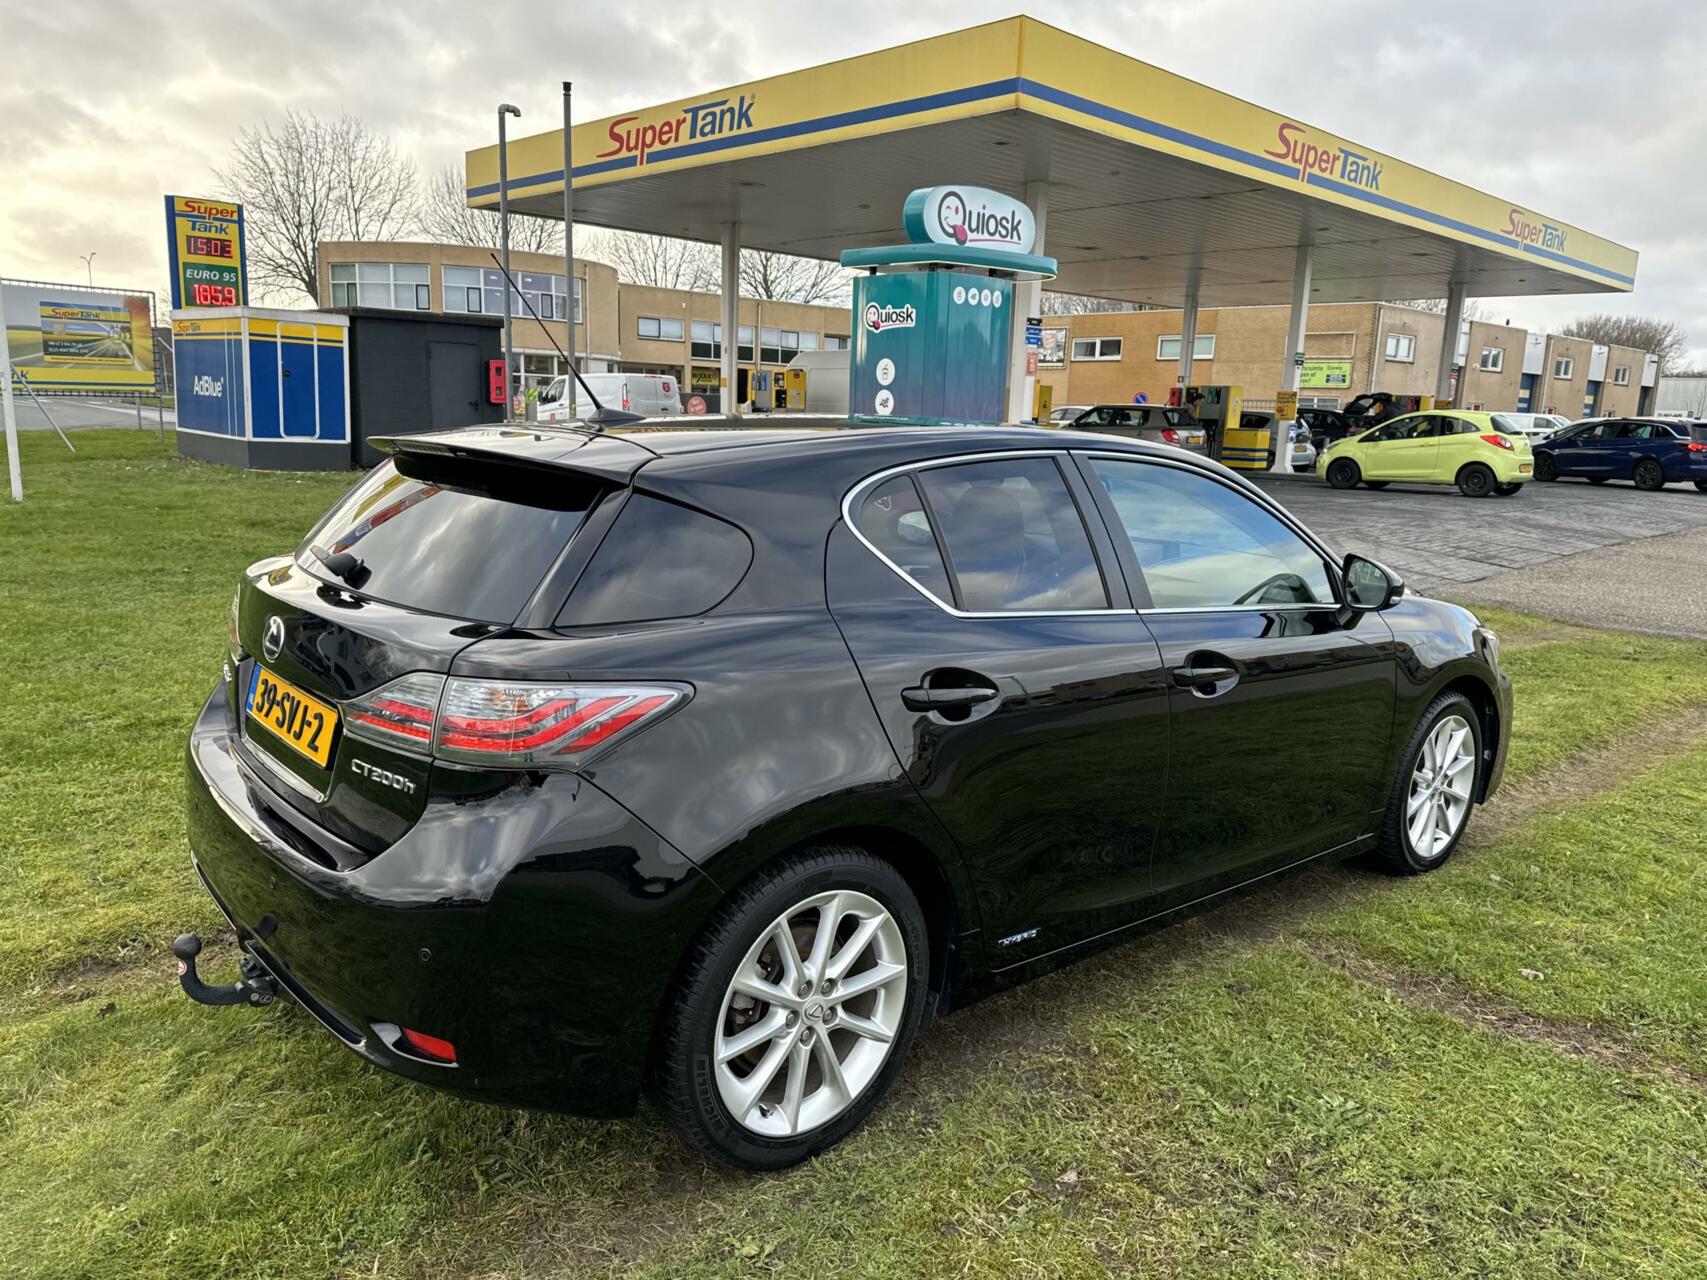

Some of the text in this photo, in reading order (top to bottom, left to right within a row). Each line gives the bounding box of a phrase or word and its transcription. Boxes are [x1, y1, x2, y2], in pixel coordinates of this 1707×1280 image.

[178, 200, 237, 221] Super
[938, 190, 1021, 245] Quiosk
[186, 219, 229, 235] Tank
[185, 268, 236, 282] EURO 95
[866, 305, 914, 330] Quiosk
[255, 678, 325, 754] 39-SVJ-2
[351, 758, 417, 794] CT200h
